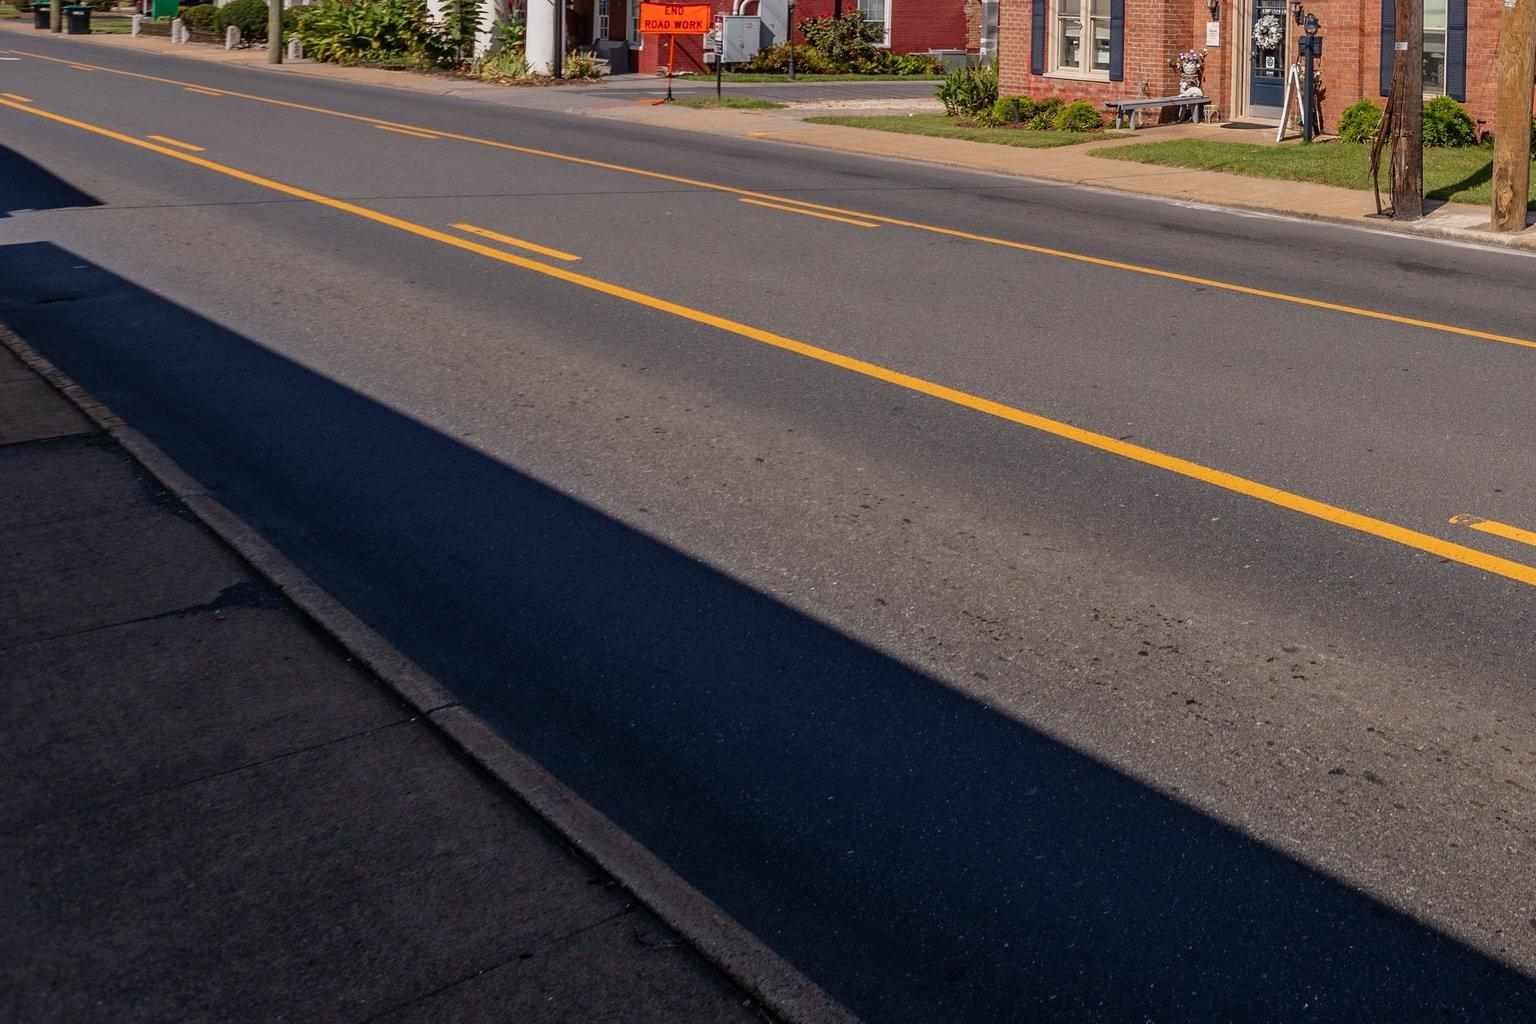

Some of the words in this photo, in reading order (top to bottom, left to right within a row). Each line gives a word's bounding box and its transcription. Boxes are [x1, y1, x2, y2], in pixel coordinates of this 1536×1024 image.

[664, 5, 684, 16] END
[644, 19, 670, 29] ROAD
[674, 20, 703, 29] WORK
